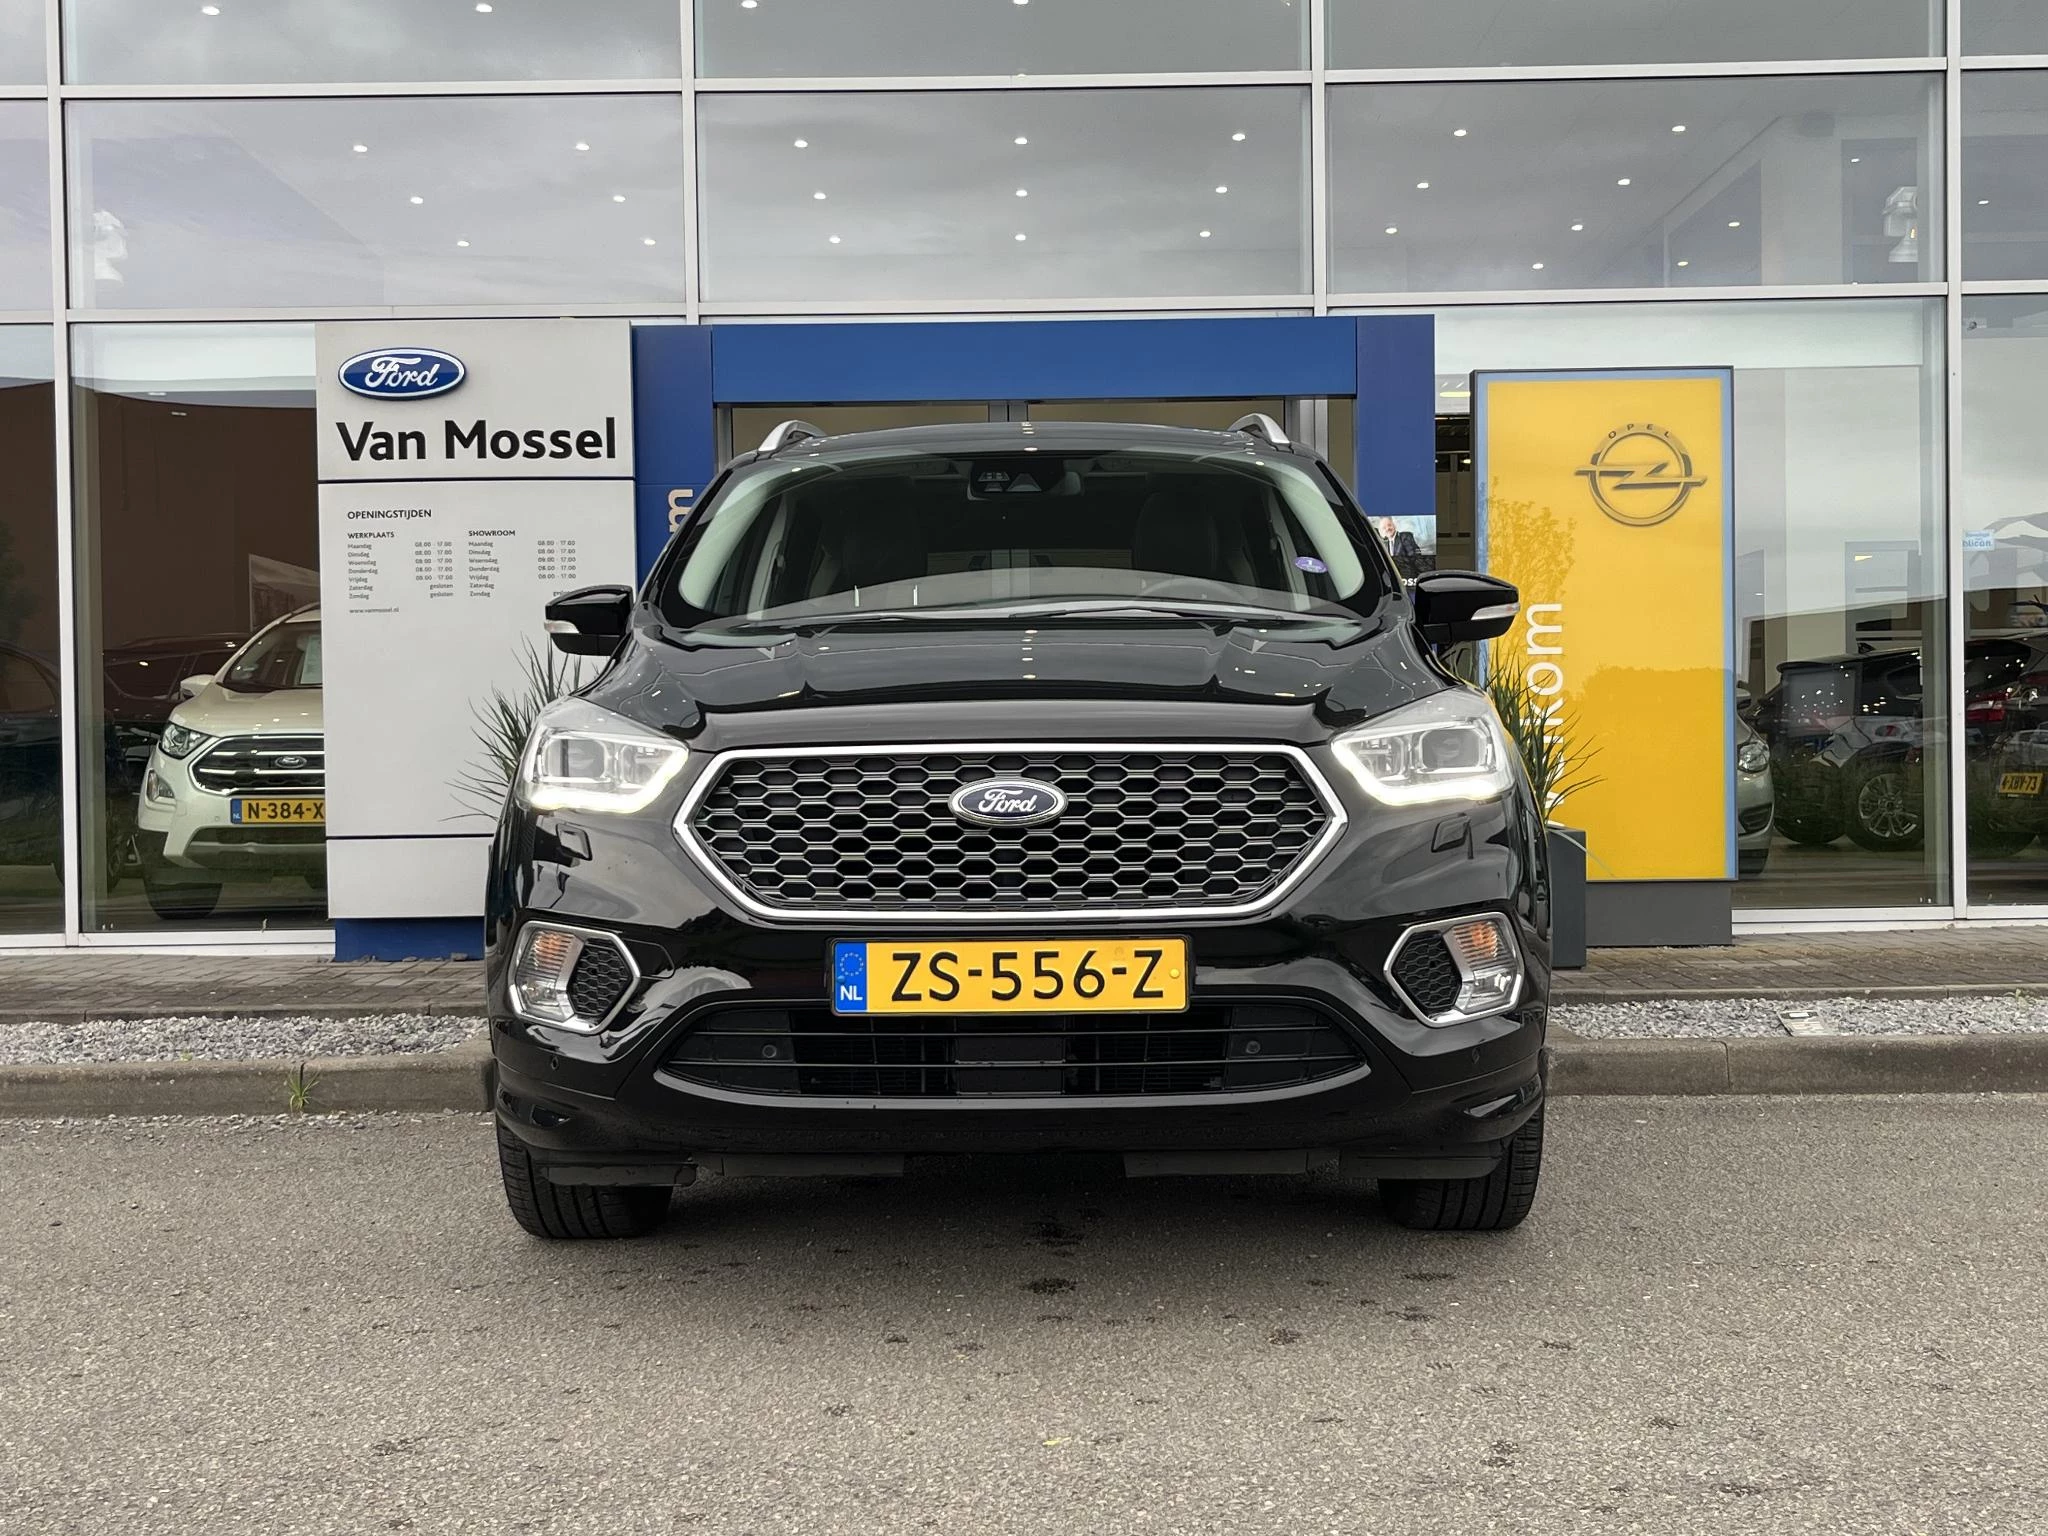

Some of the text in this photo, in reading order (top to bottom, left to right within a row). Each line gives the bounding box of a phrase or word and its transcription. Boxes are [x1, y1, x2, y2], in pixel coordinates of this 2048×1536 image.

[364, 356, 440, 388] Ford
[336, 417, 616, 461] Van Mossel
[1608, 423, 1671, 439] OPEL
[347, 509, 432, 520] OPENINGSTIJDEN
[347, 531, 395, 539] WERKPLAATS
[248, 802, 324, 819] N-384-X
[978, 788, 1038, 813] Ford
[839, 950, 1164, 1001] NL ZS-556-Z
